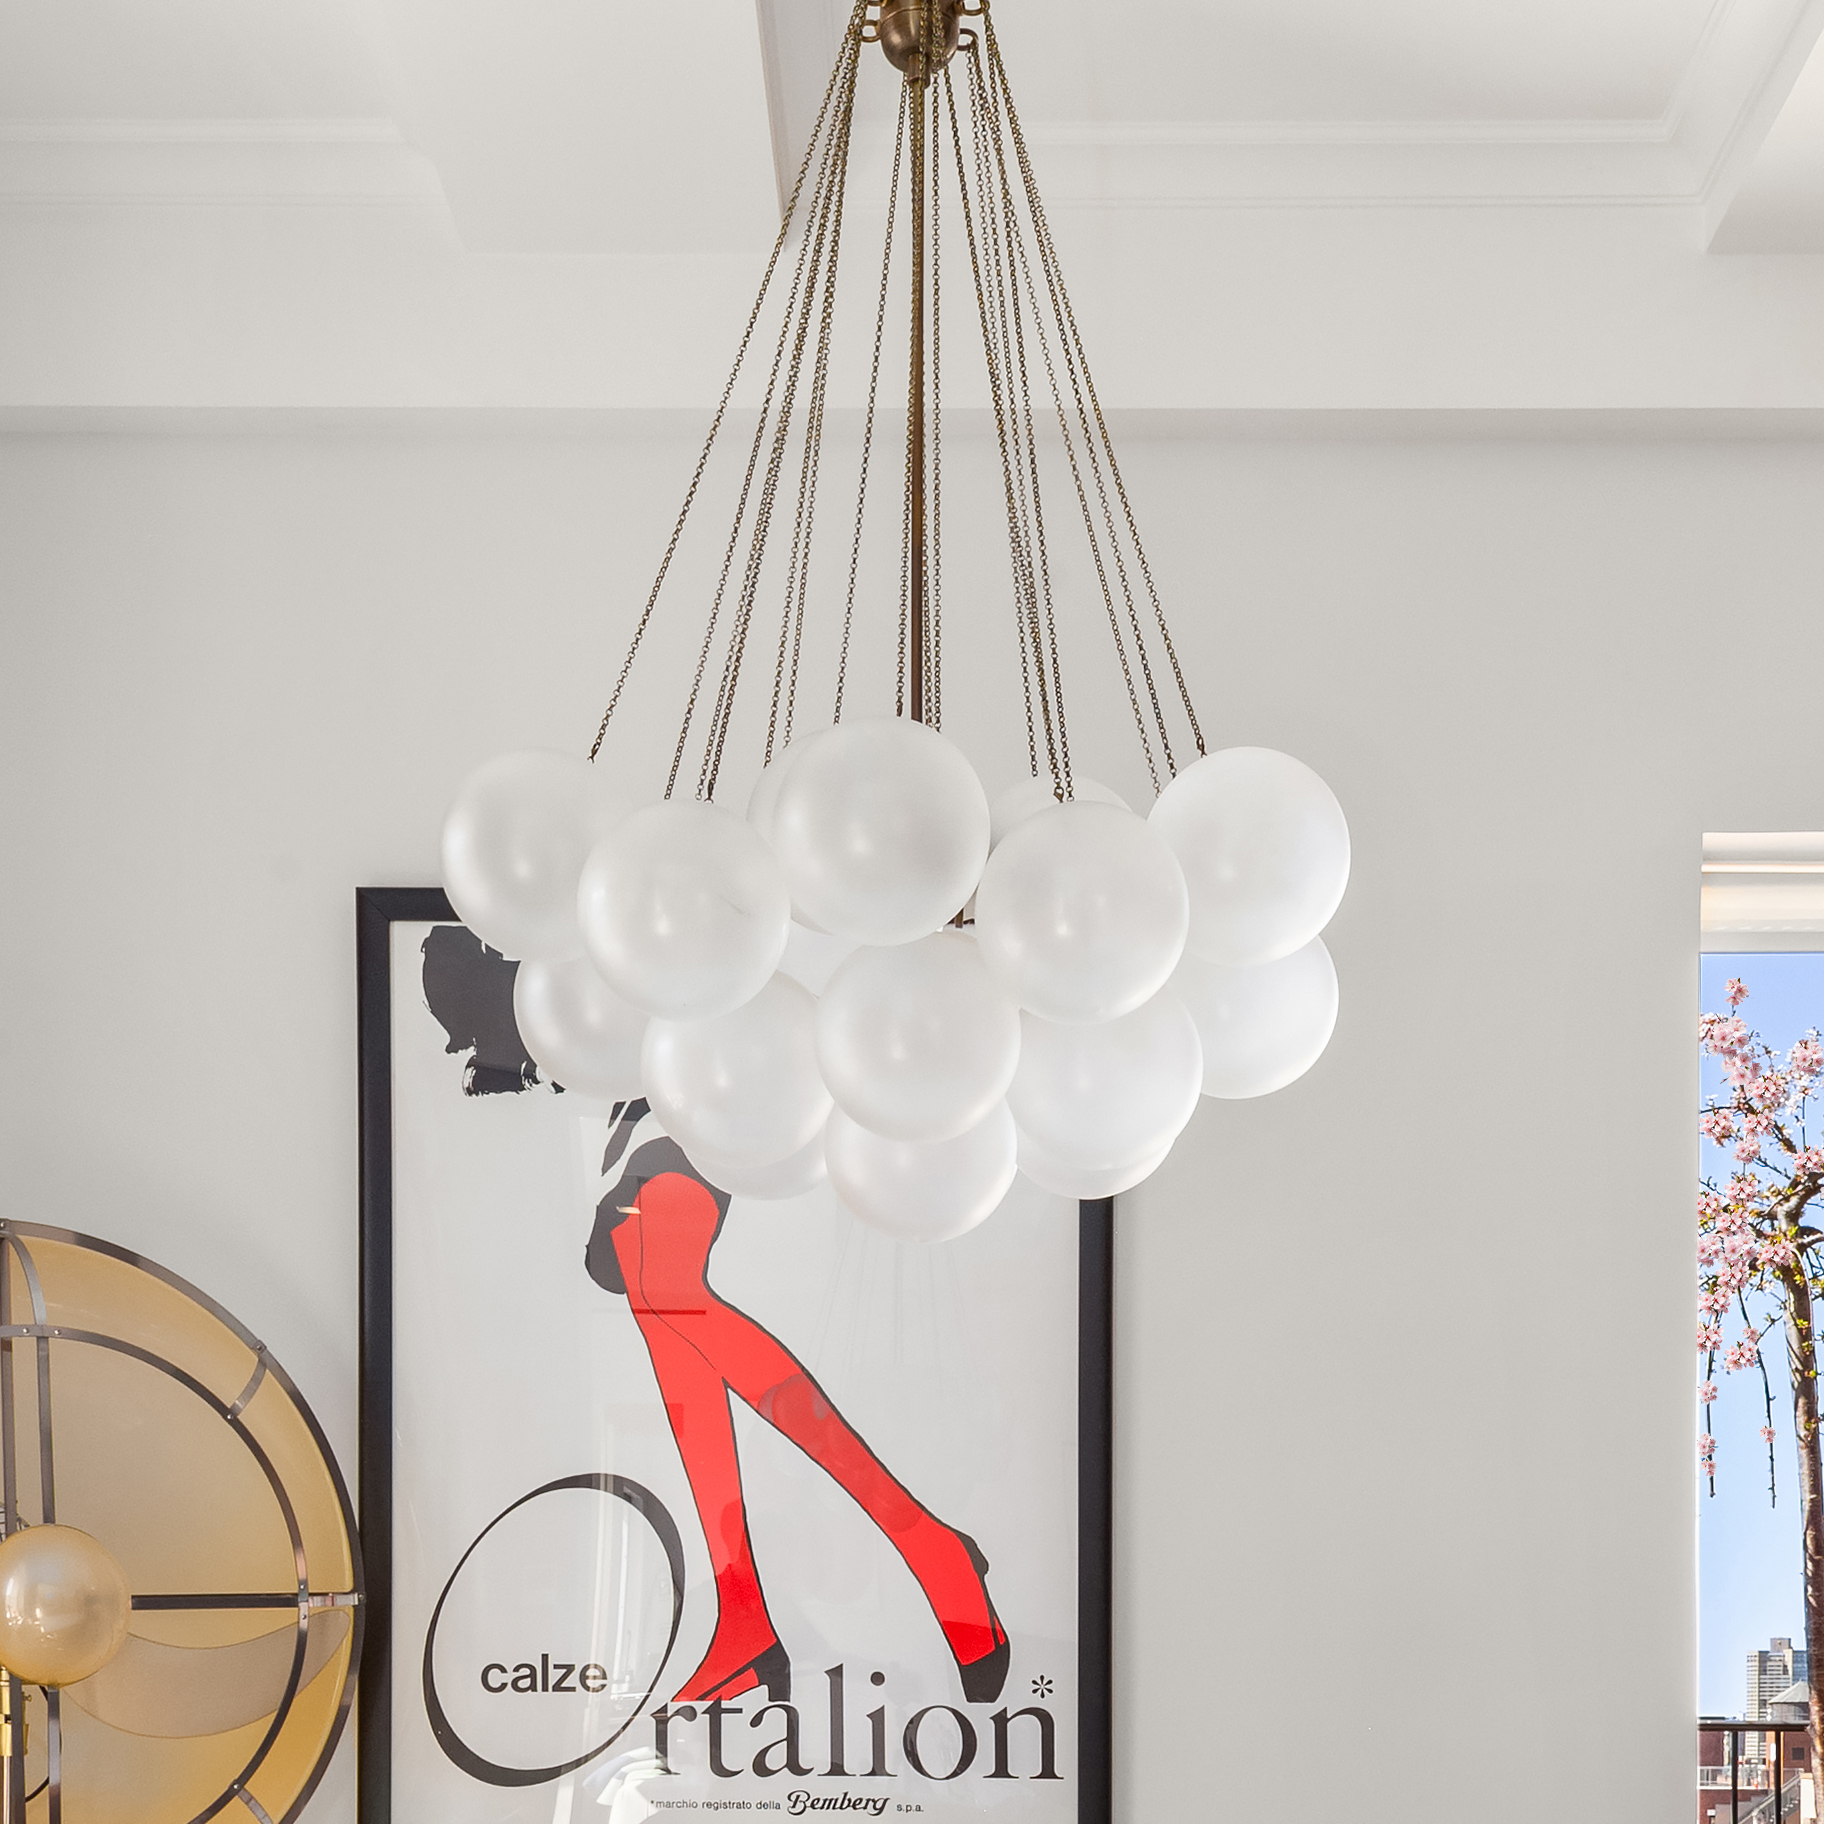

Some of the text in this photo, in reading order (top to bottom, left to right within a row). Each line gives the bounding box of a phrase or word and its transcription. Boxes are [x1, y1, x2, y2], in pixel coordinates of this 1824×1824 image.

[480, 1653, 609, 1694] calze
[701, 1800, 752, 1812] registrato
[755, 1800, 781, 1811] della
[787, 1789, 890, 1817] Bemberg
[896, 1802, 924, 1813] s.p.a.
